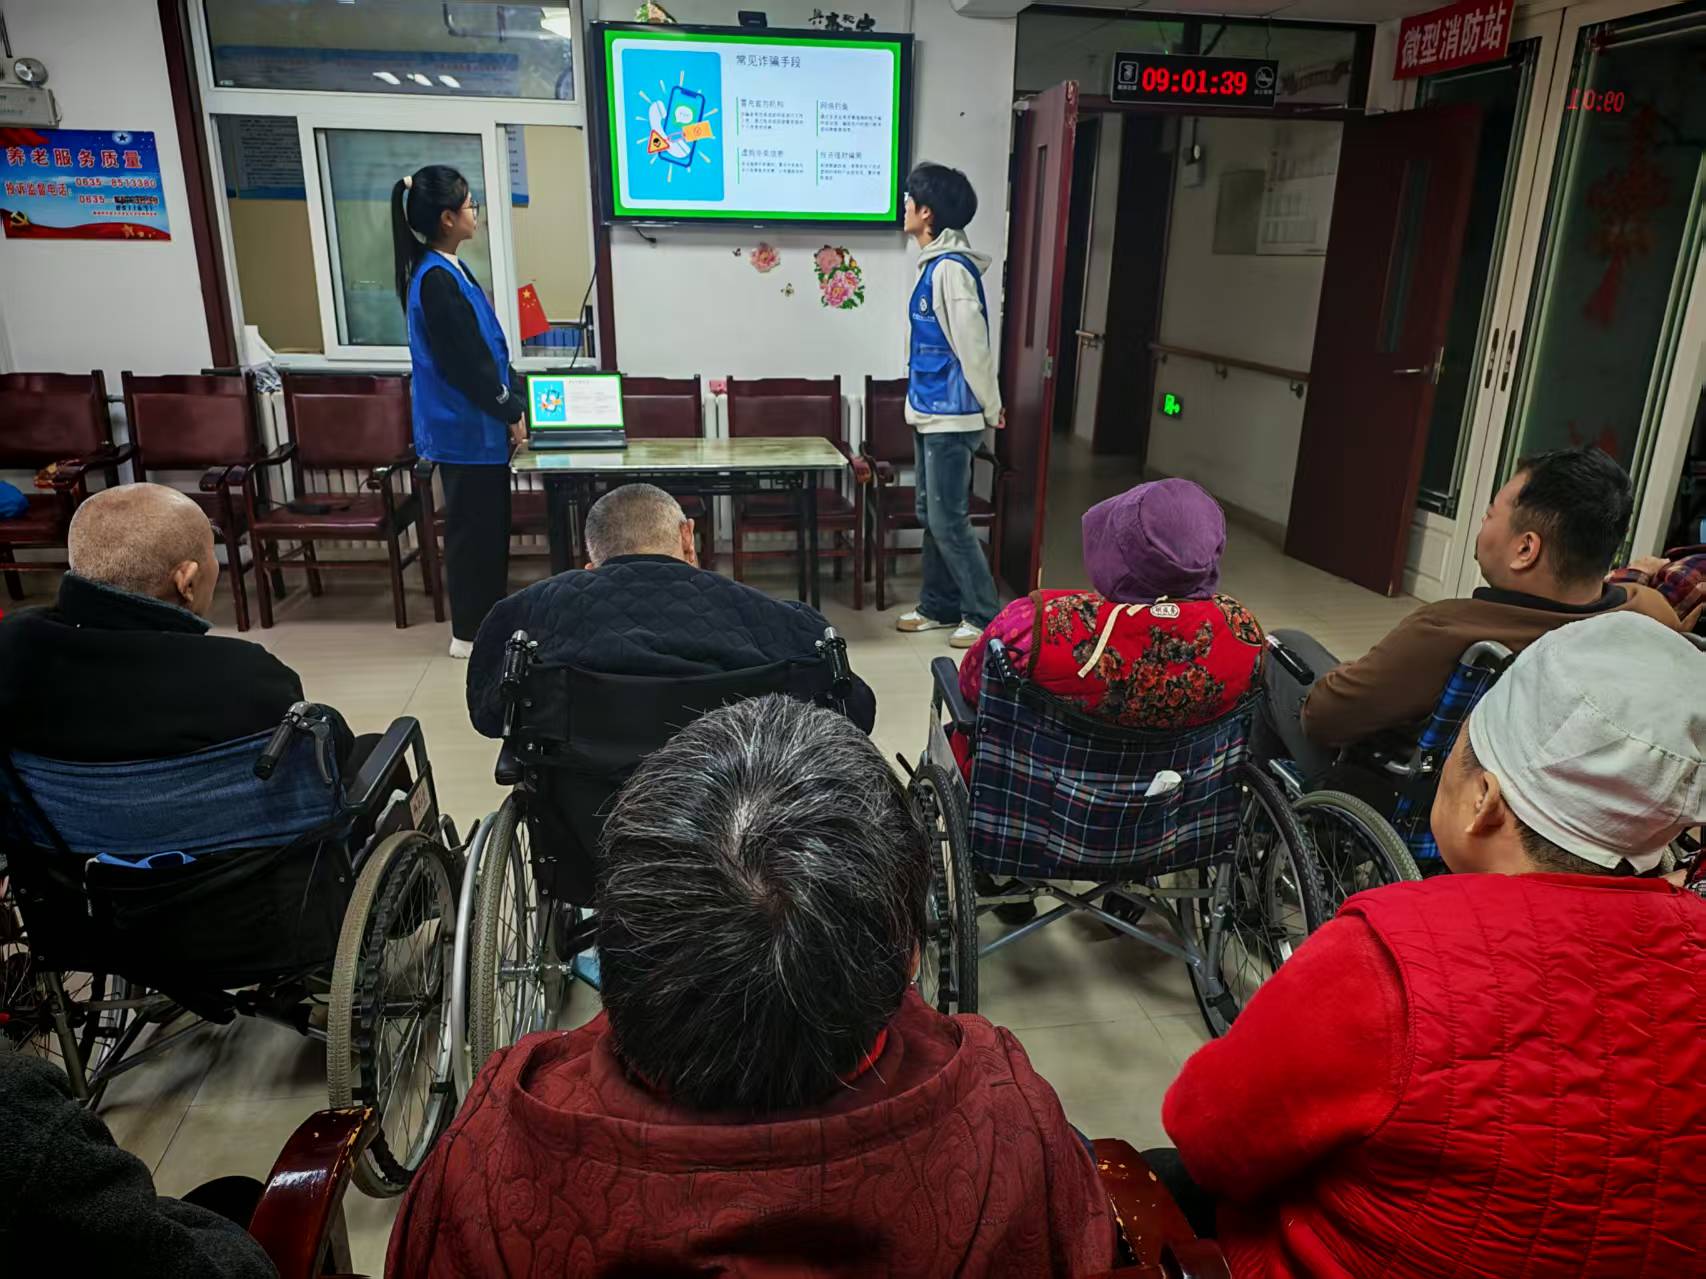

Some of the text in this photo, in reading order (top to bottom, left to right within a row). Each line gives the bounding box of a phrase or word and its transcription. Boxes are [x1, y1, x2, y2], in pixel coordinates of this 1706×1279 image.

[1401, 2, 1506, 69] 微型消防站
[736, 54, 801, 68] 常见诈骗手段
[1142, 67, 1248, 95] 09:01:39
[6, 147, 142, 168] 养老服务质量
